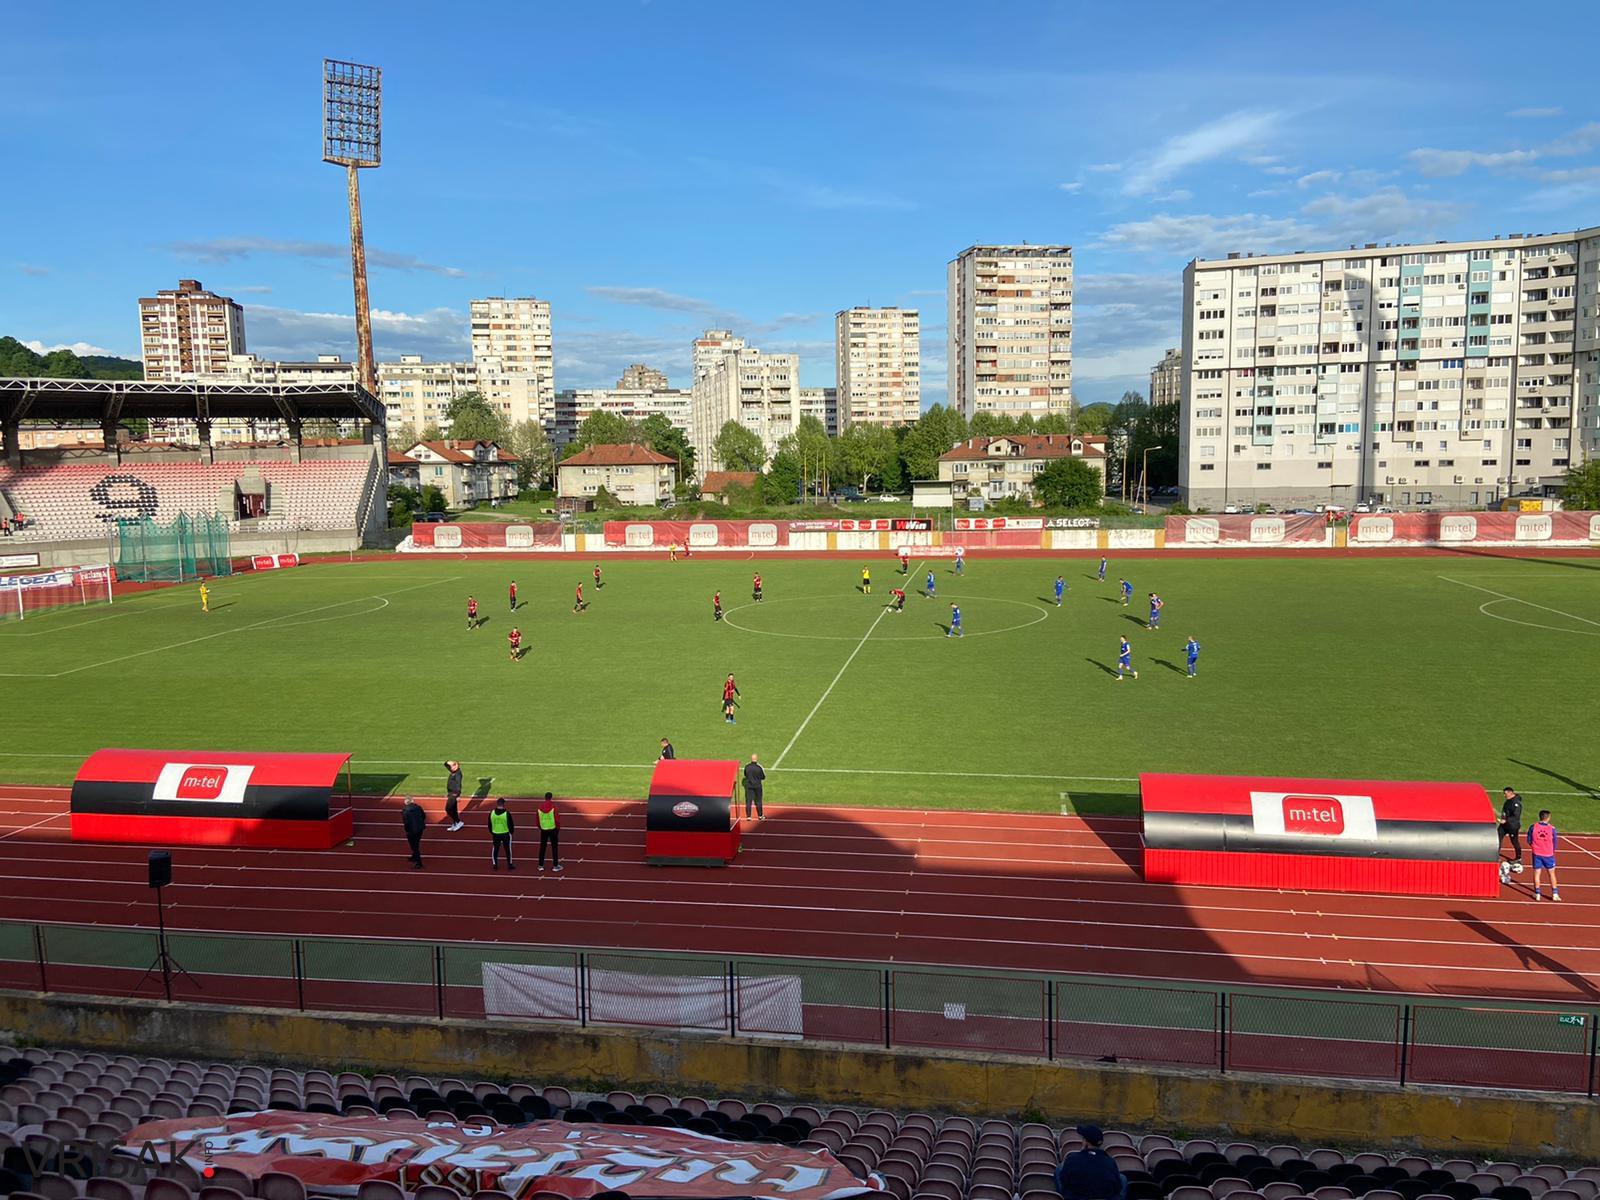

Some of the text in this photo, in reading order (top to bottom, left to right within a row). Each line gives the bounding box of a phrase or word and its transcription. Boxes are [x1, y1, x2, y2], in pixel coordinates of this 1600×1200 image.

[1056, 518, 1090, 528] SELECT
[1520, 522, 1547, 532] m:tel
[1254, 525, 1280, 534] m:tel
[1362, 524, 1388, 533] m:tel
[1444, 524, 1472, 533] m:tel
[184, 775, 220, 788] m:tel
[1290, 807, 1336, 822] m:tel
